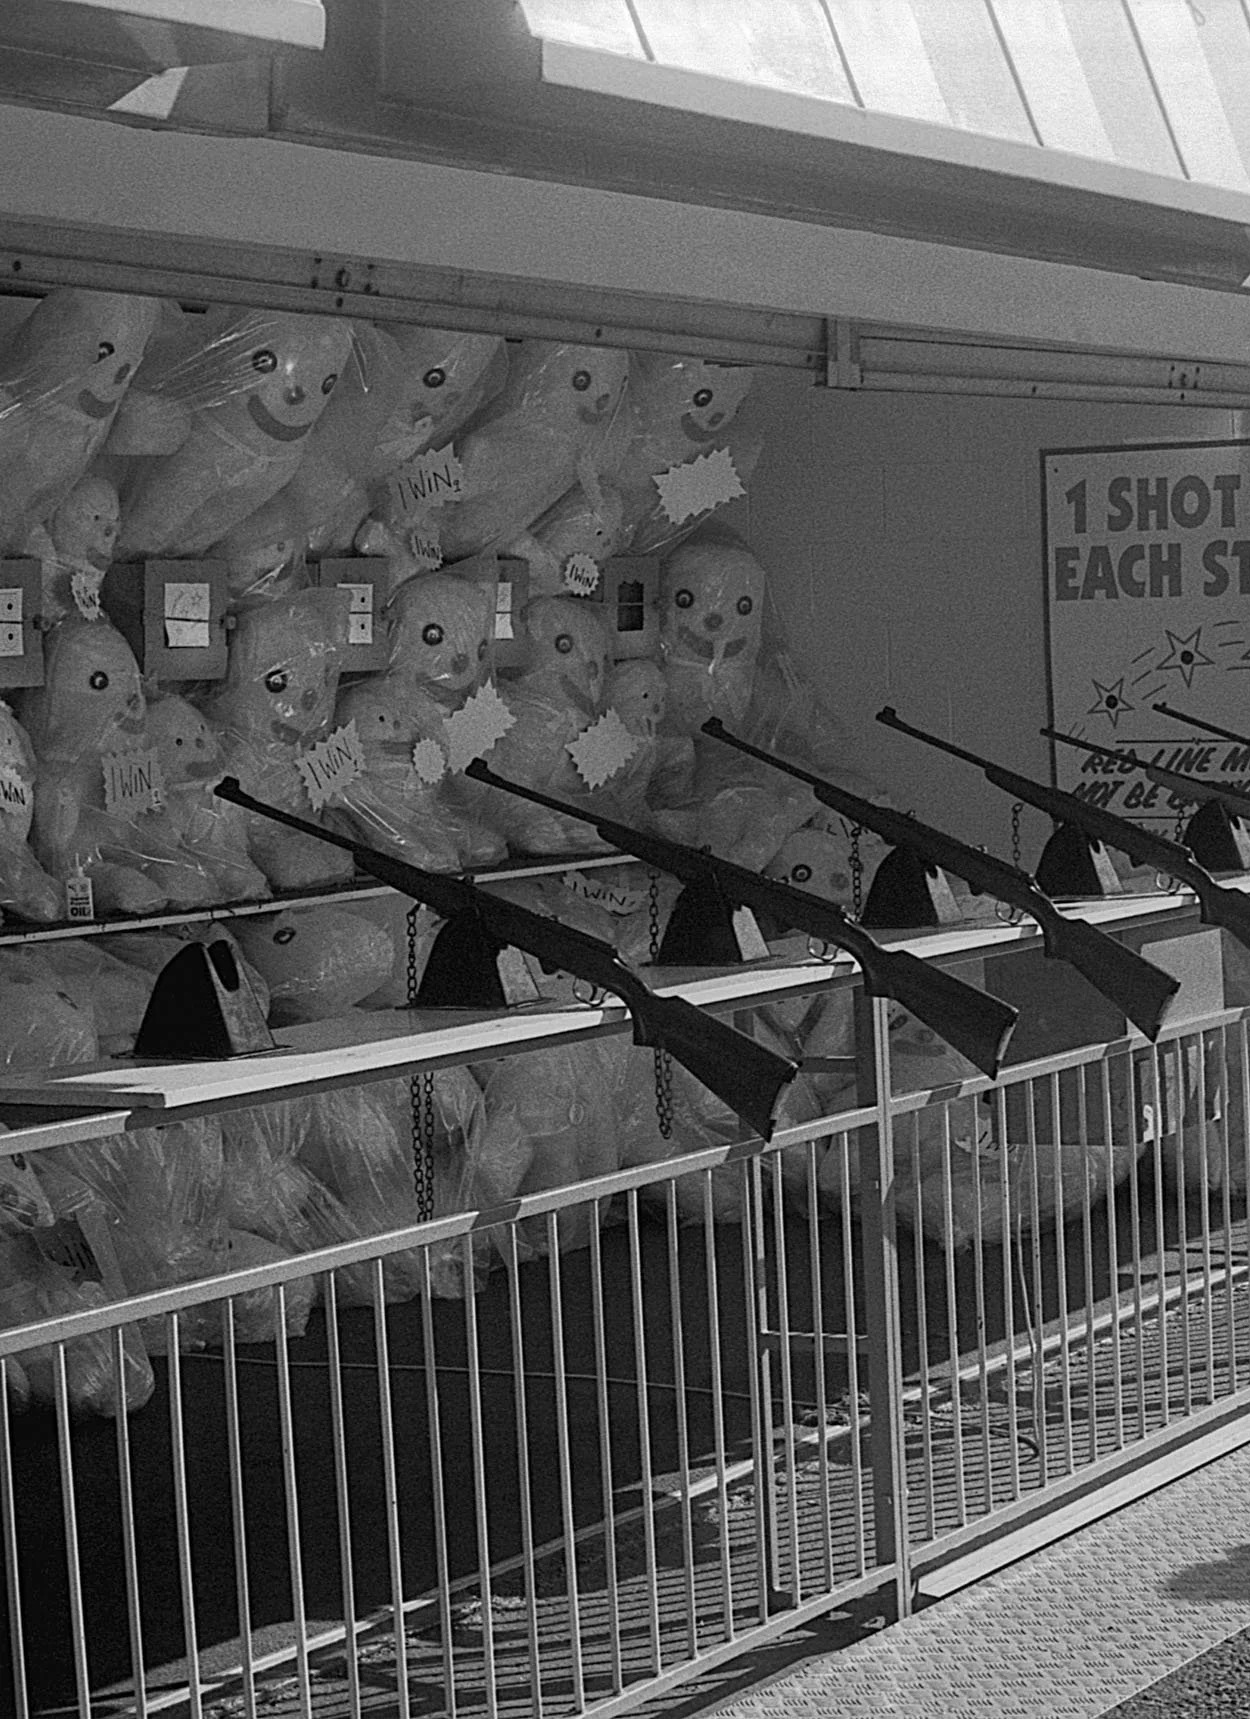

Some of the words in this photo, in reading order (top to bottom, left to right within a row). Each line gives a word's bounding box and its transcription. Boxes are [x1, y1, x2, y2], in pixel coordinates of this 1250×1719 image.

[1065, 478, 1087, 534] 1
[1106, 474, 1241, 533] SHOT
[1054, 542, 1183, 601] EACH
[1122, 780, 1160, 809] BE
